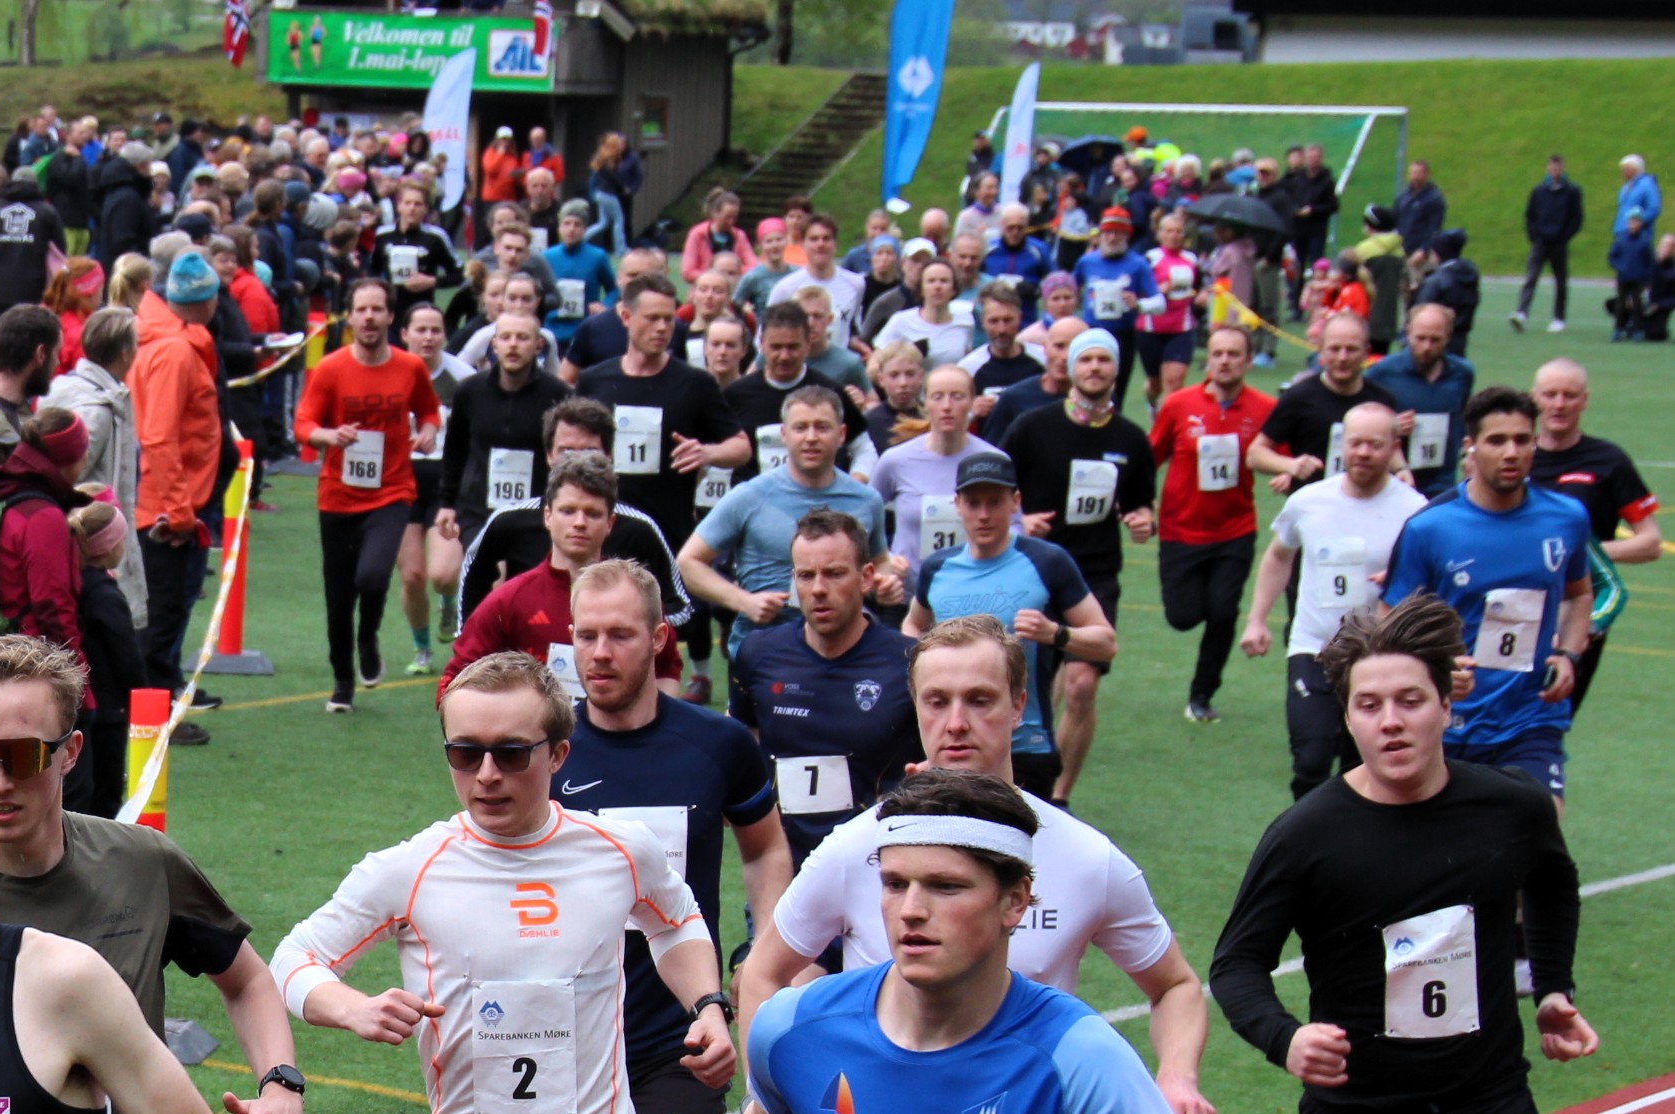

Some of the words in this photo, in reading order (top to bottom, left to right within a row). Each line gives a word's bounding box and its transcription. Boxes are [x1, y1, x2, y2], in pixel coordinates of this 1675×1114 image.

[343, 21, 445, 46] Velkomen
[449, 23, 474, 47] til
[628, 443, 647, 463] 11
[348, 460, 377, 479] 168
[1210, 464, 1229, 481] 14
[494, 481, 526, 500] 196
[705, 480, 726, 498] 30
[1076, 496, 1106, 515] 191
[933, 530, 957, 550] 31
[1334, 574, 1347, 597] 9
[1498, 631, 1517, 658] 8
[773, 705, 811, 718] TRIMTEX
[803, 764, 820, 796] 7
[1422, 980, 1447, 1018] 6
[511, 1056, 538, 1101] 2
